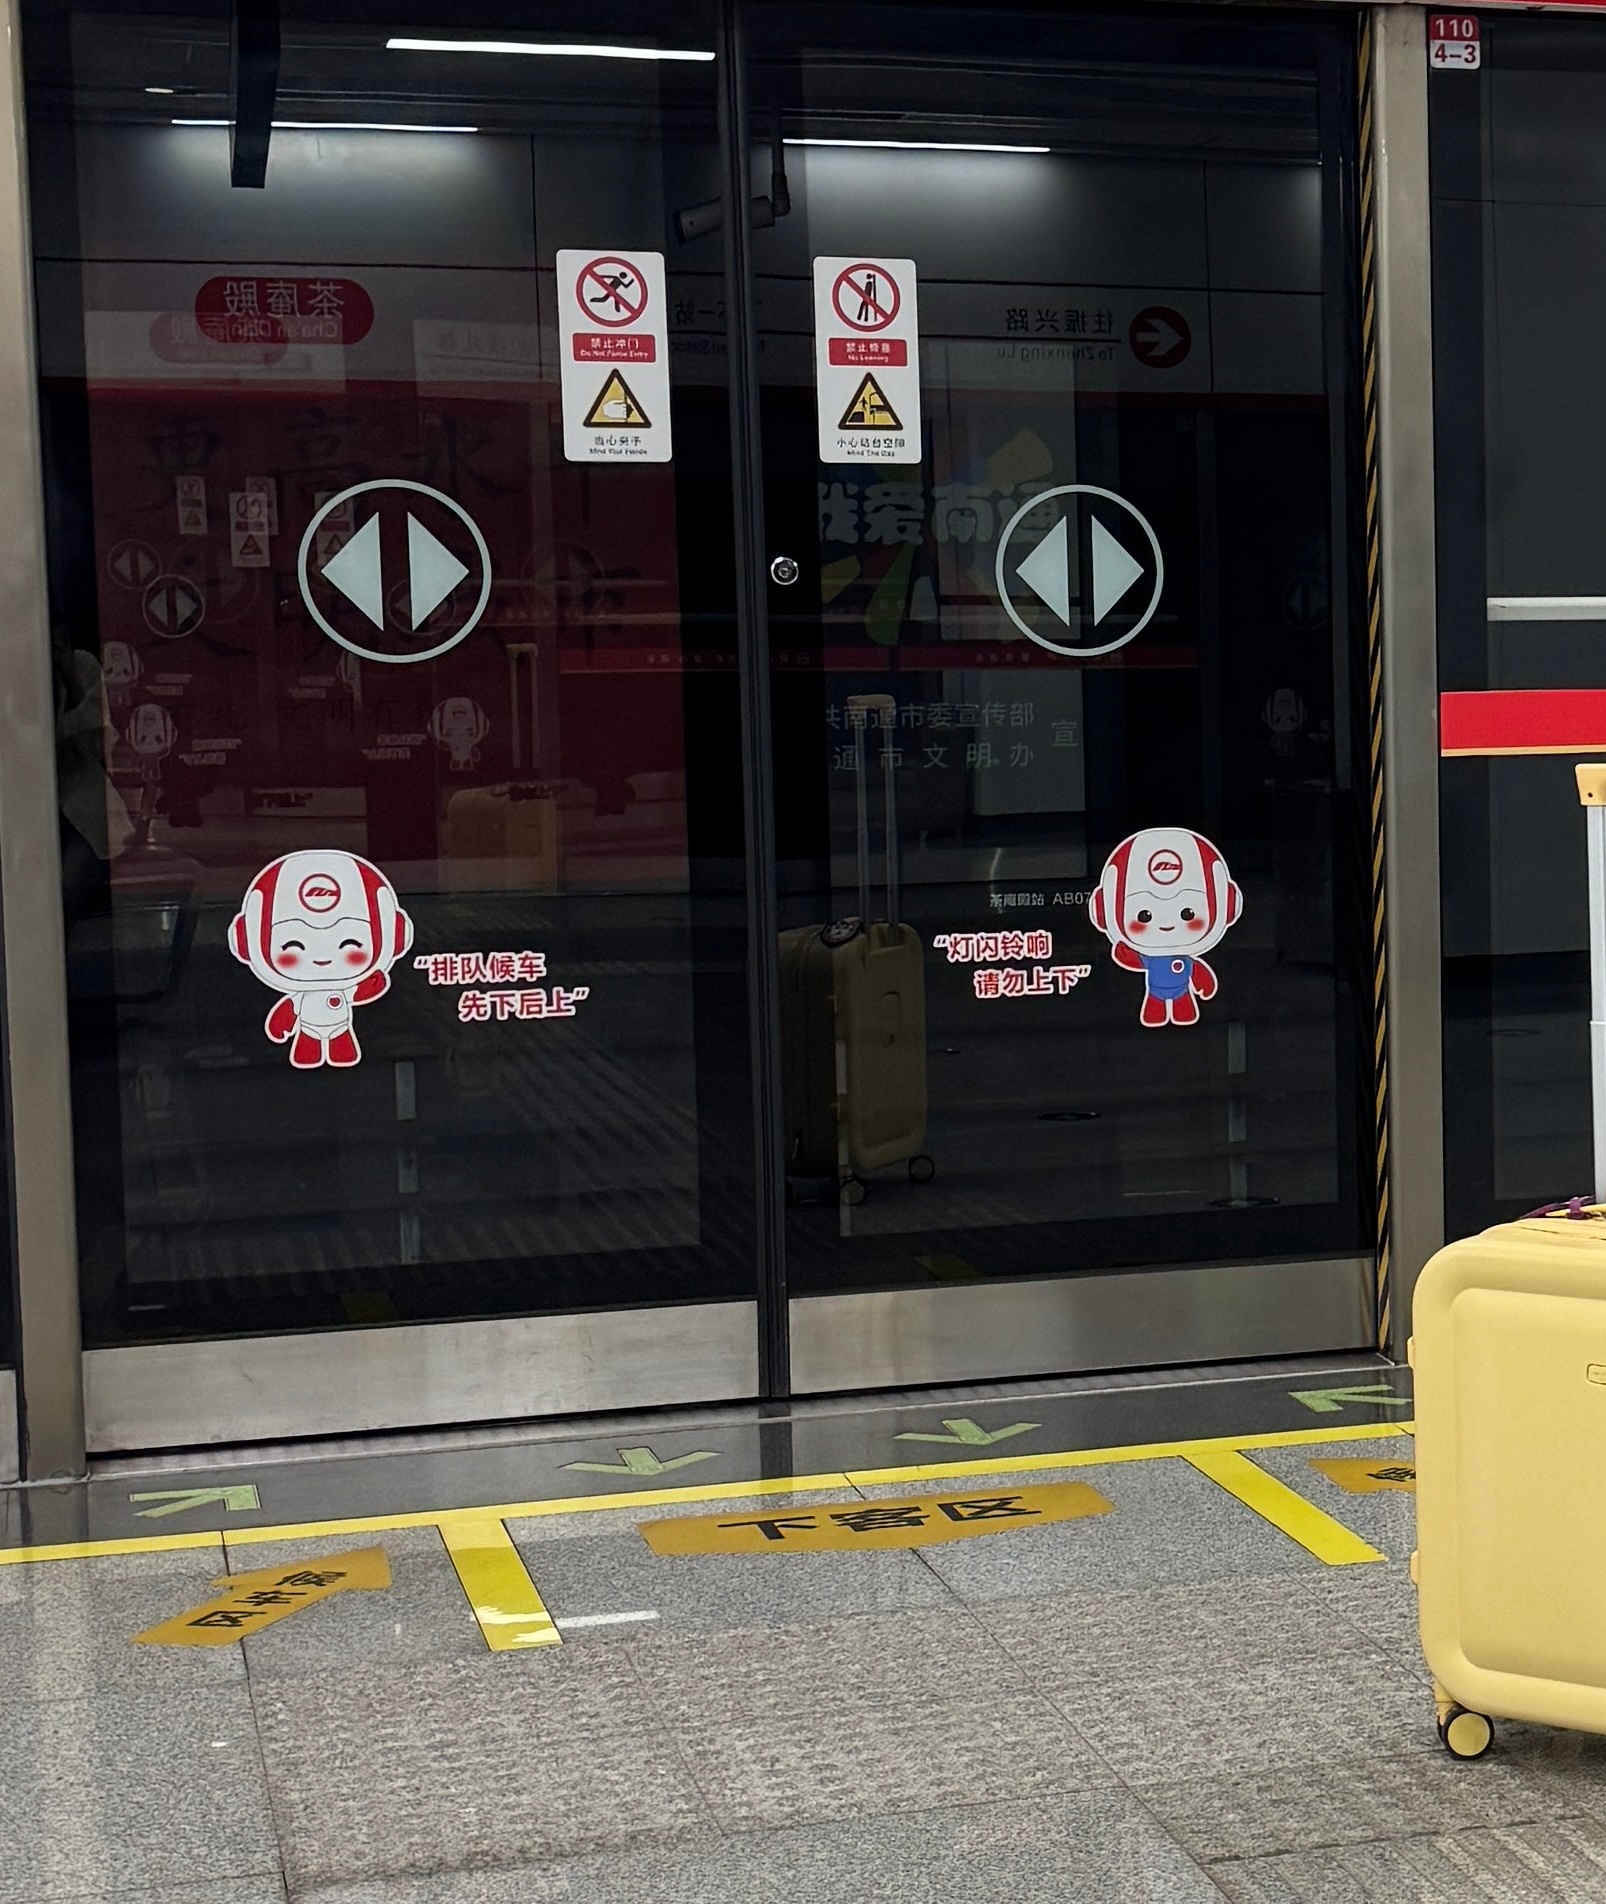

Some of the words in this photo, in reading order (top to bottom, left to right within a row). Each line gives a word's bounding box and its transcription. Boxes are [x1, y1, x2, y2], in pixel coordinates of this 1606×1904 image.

[1435, 17, 1473, 38] 110
[1434, 43, 1477, 65] 4-3
[717, 1495, 1042, 1541] 下客区
